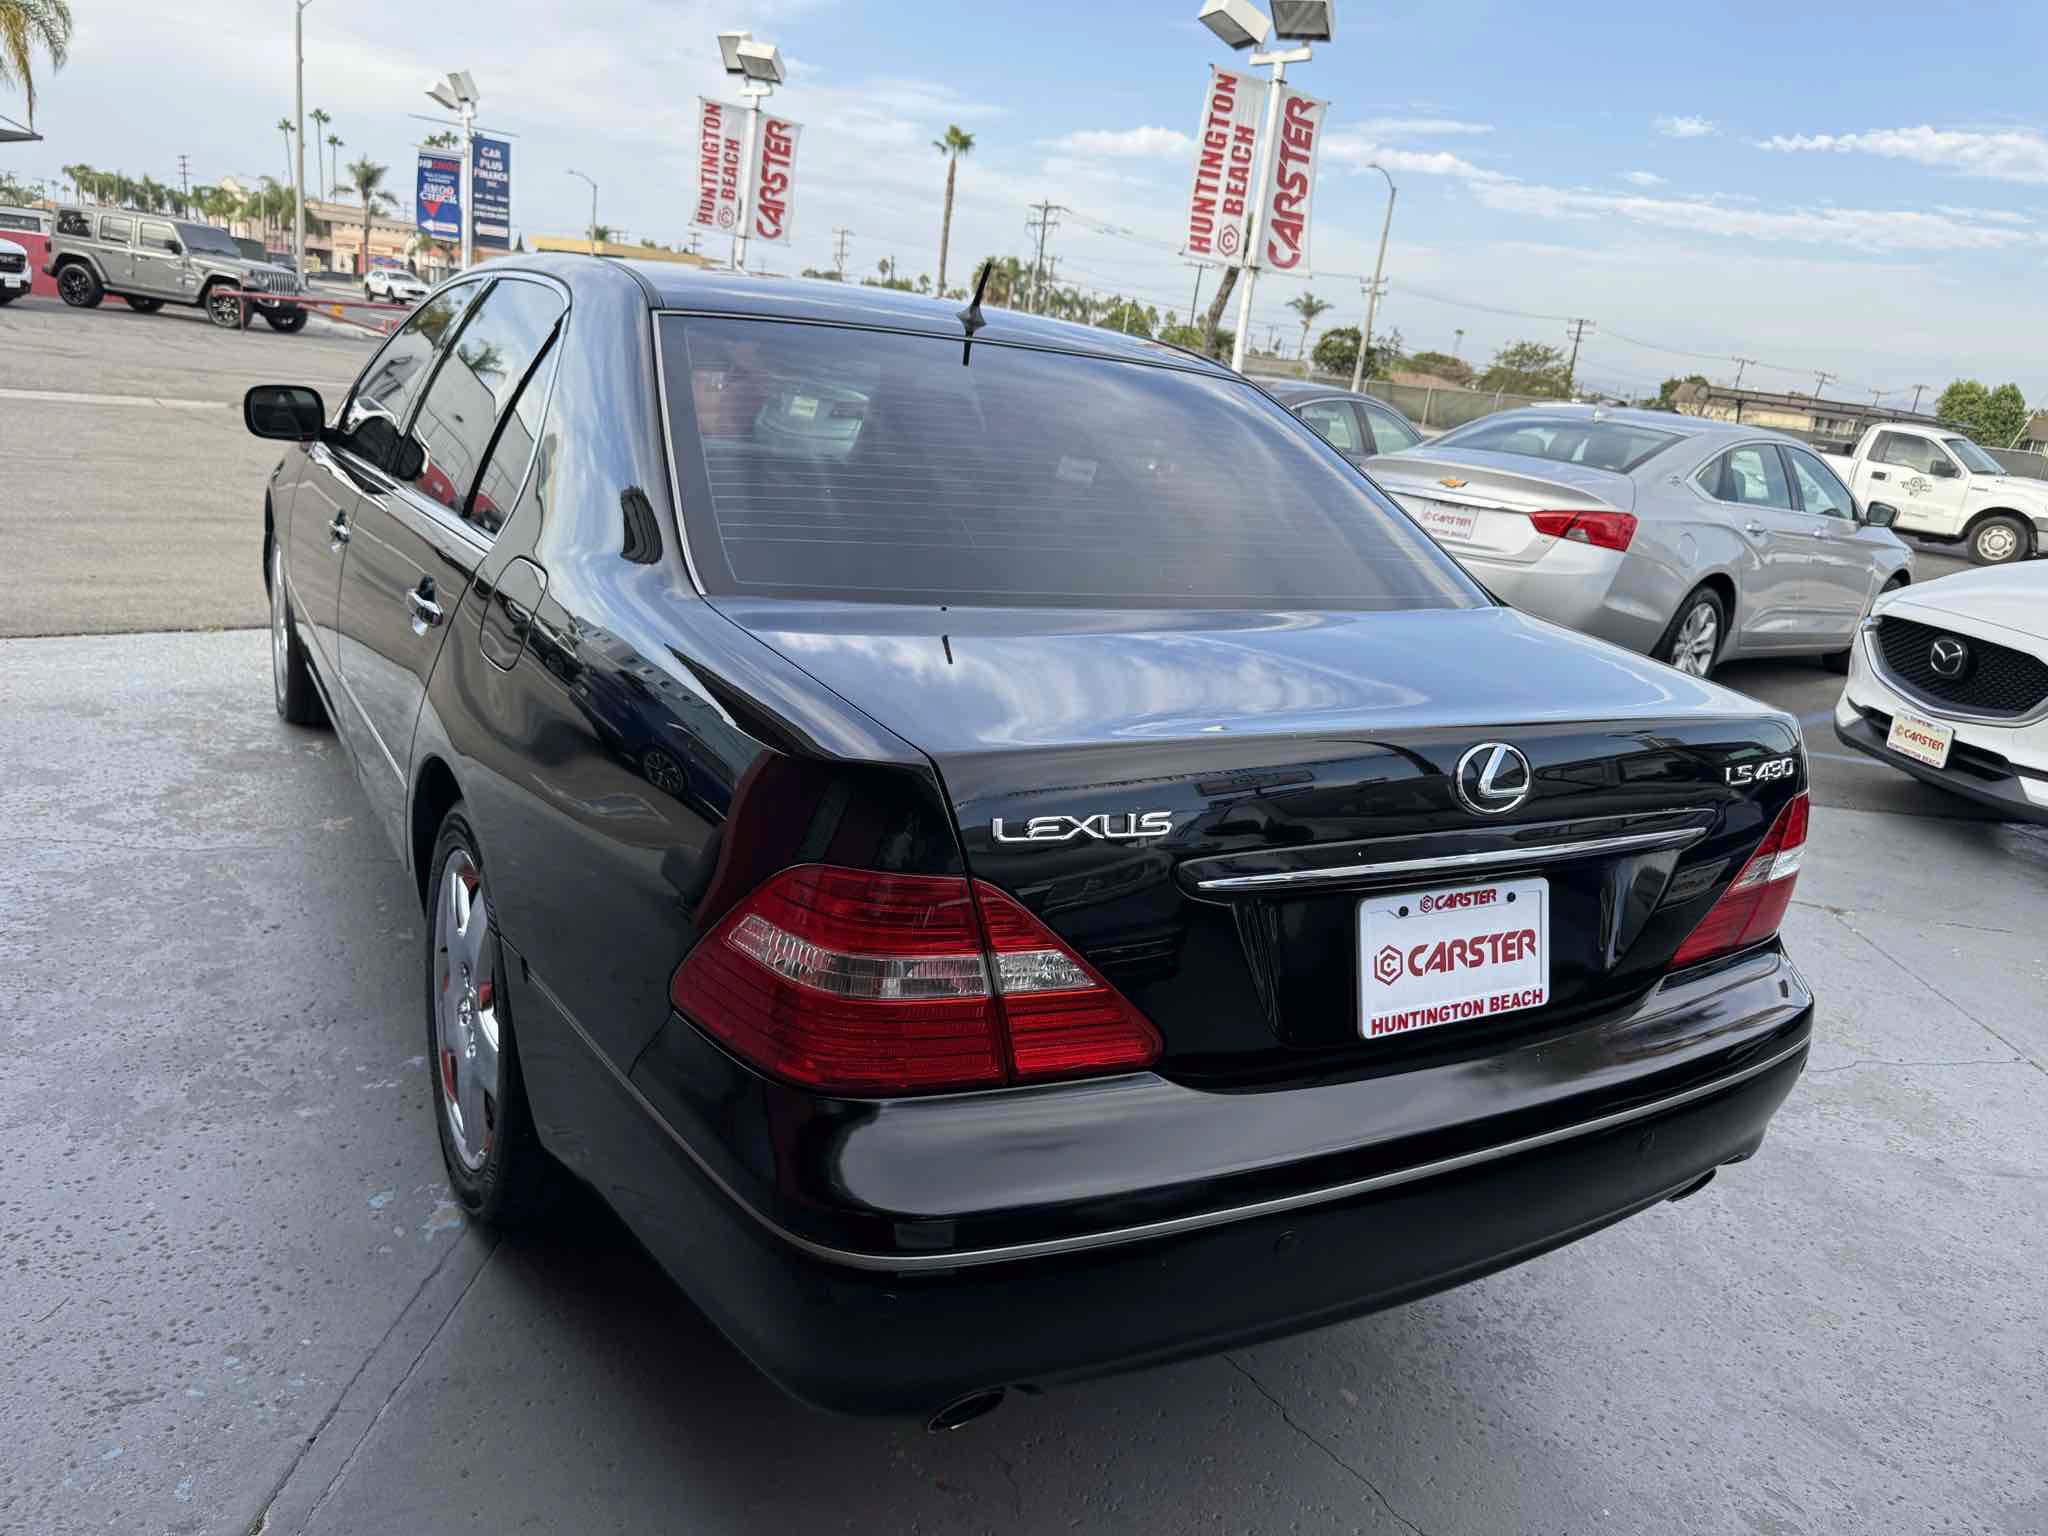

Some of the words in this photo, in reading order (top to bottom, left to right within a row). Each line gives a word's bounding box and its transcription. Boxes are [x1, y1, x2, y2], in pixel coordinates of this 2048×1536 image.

[697, 101, 722, 226] HUNTINGTON
[720, 137, 740, 201] BEACH
[756, 119, 793, 239] CARSTER
[1189, 73, 1238, 254] HUNTINGTON
[1222, 124, 1256, 217] BEACH
[1267, 96, 1317, 269] CARSTER
[1904, 729, 1945, 752] CARSTER
[1725, 764, 1753, 786] LS
[1755, 757, 1794, 780] 430
[991, 811, 1172, 843] LEXUS
[1434, 888, 1497, 911] CARSTER
[1407, 928, 1537, 977] CARSTER
[1371, 999, 1485, 1036] HUNTINGTON
[1489, 988, 1544, 1013] BEACH
